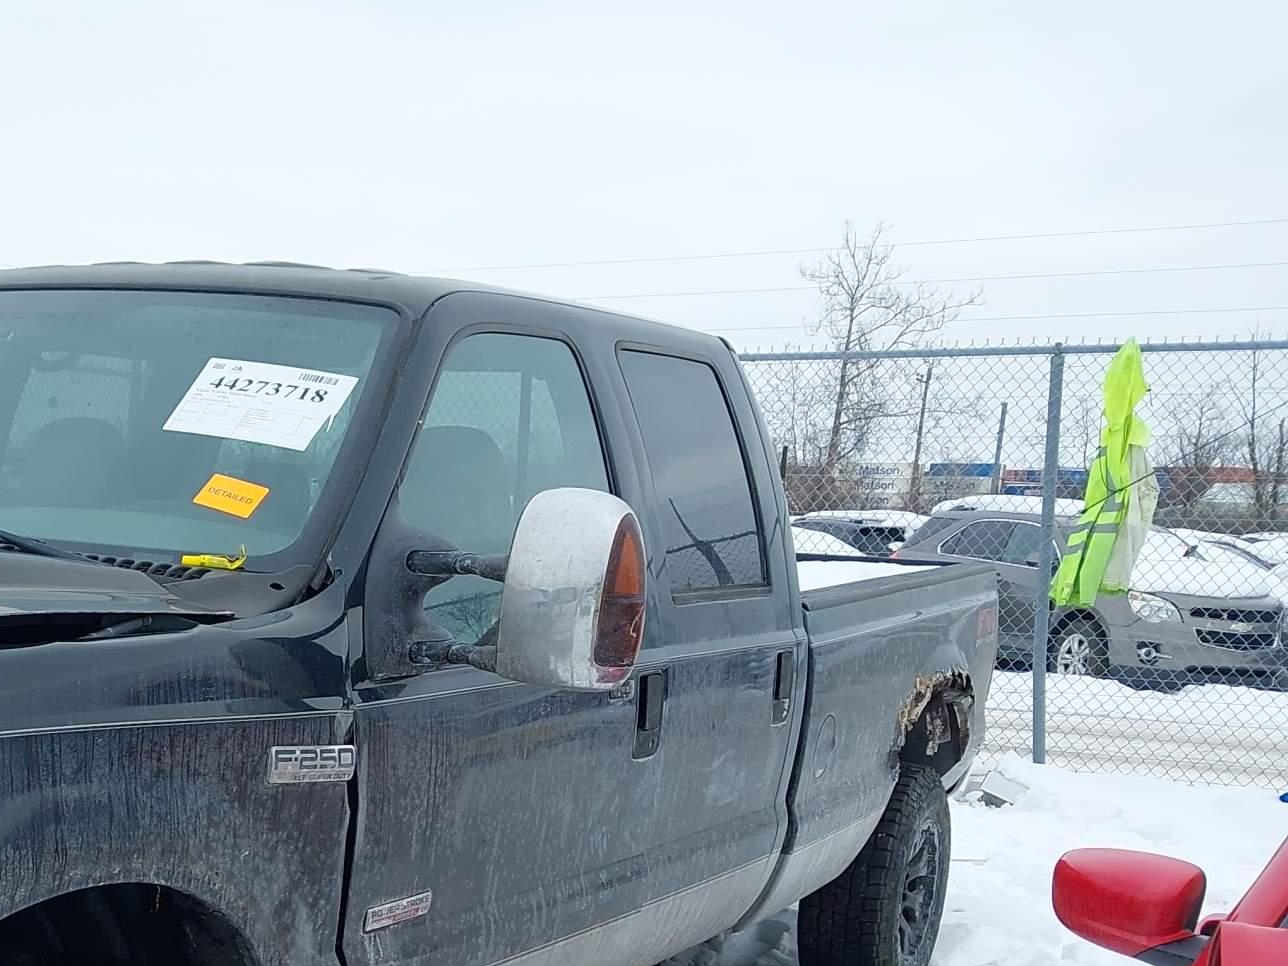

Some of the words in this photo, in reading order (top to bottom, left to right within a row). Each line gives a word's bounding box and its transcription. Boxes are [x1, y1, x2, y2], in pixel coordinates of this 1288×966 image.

[209, 376, 328, 403] 44273718
[859, 465, 900, 475] Matson
[208, 486, 254, 505] DETAILED
